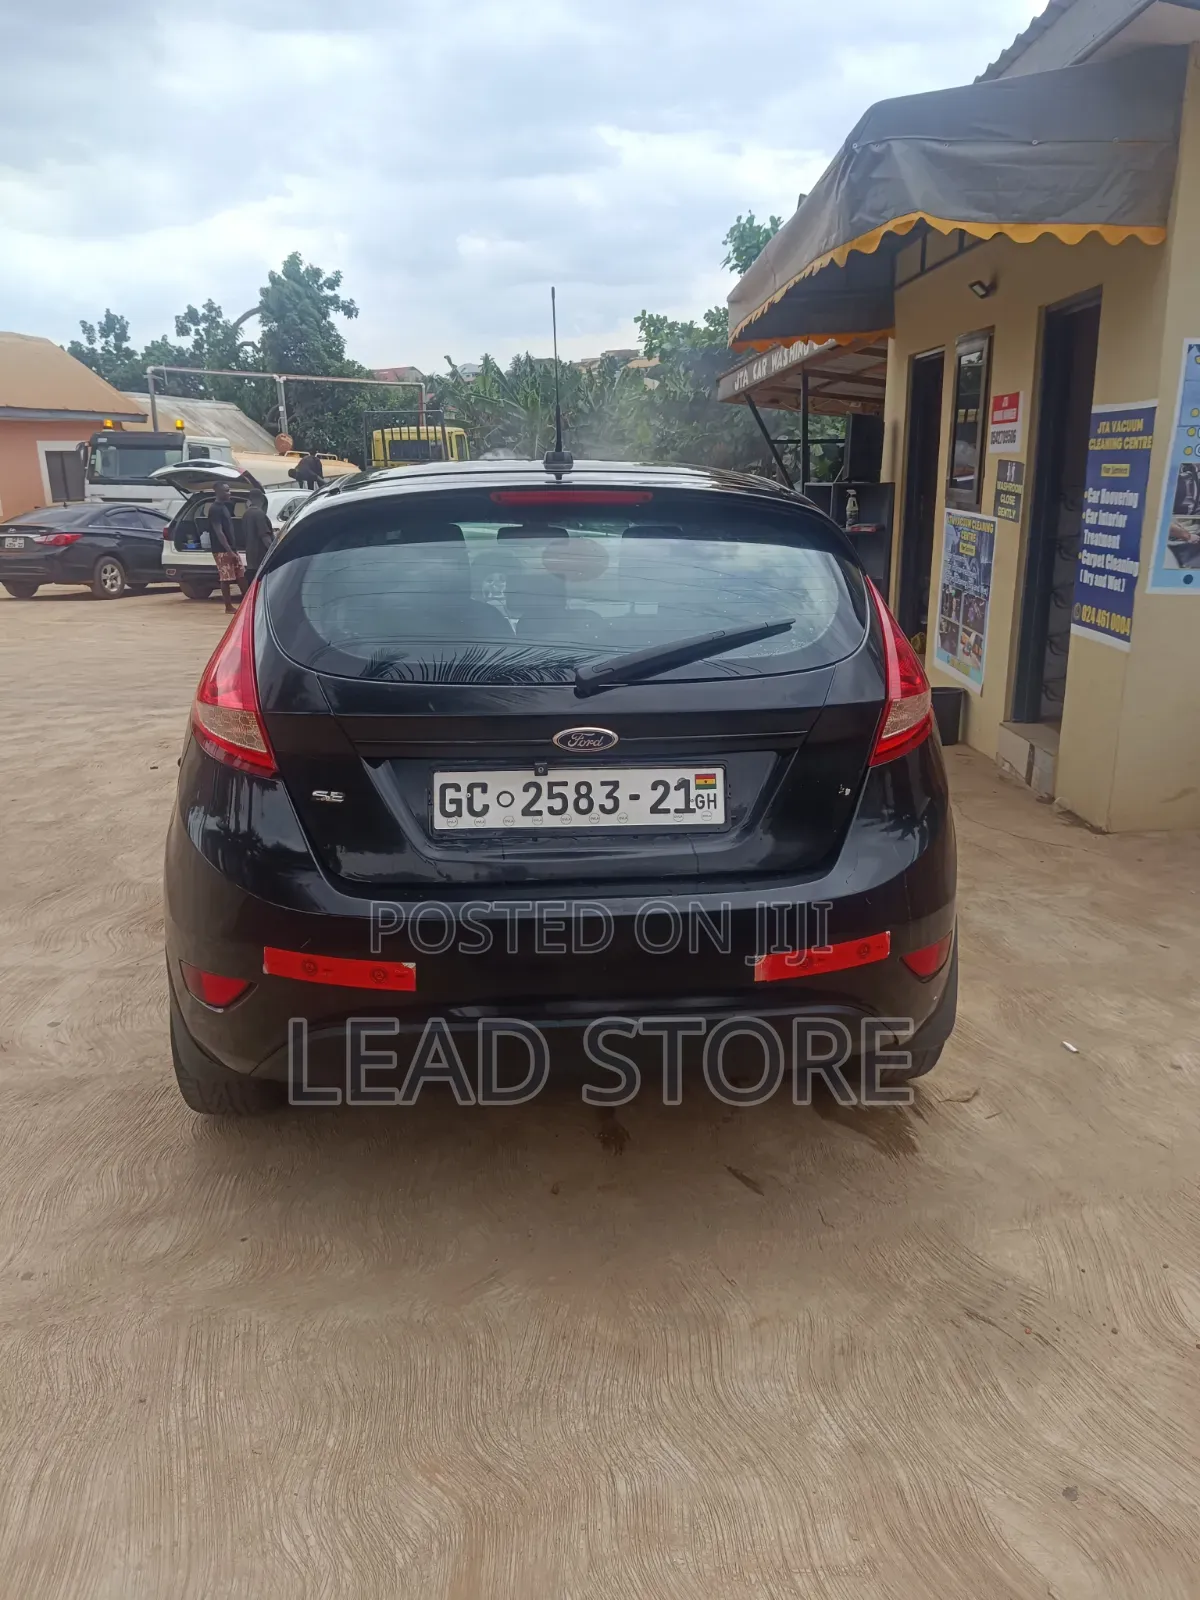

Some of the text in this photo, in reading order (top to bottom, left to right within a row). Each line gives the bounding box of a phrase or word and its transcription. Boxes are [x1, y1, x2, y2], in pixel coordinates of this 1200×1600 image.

[735, 369, 749, 391] JTA
[752, 357, 769, 381] CAR
[1112, 418, 1144, 432] VACUUM
[1088, 435, 1153, 450] CLEANING CENTRE
[1000, 494, 1016, 506] CLOSE
[1087, 487, 1100, 504] Car
[1085, 508, 1128, 528] Car Interior
[1084, 529, 1120, 549] Treatment
[1081, 549, 1140, 577] Carpet Cleaning
[567, 732, 604, 748] Ford
[695, 794, 717, 810] GH
